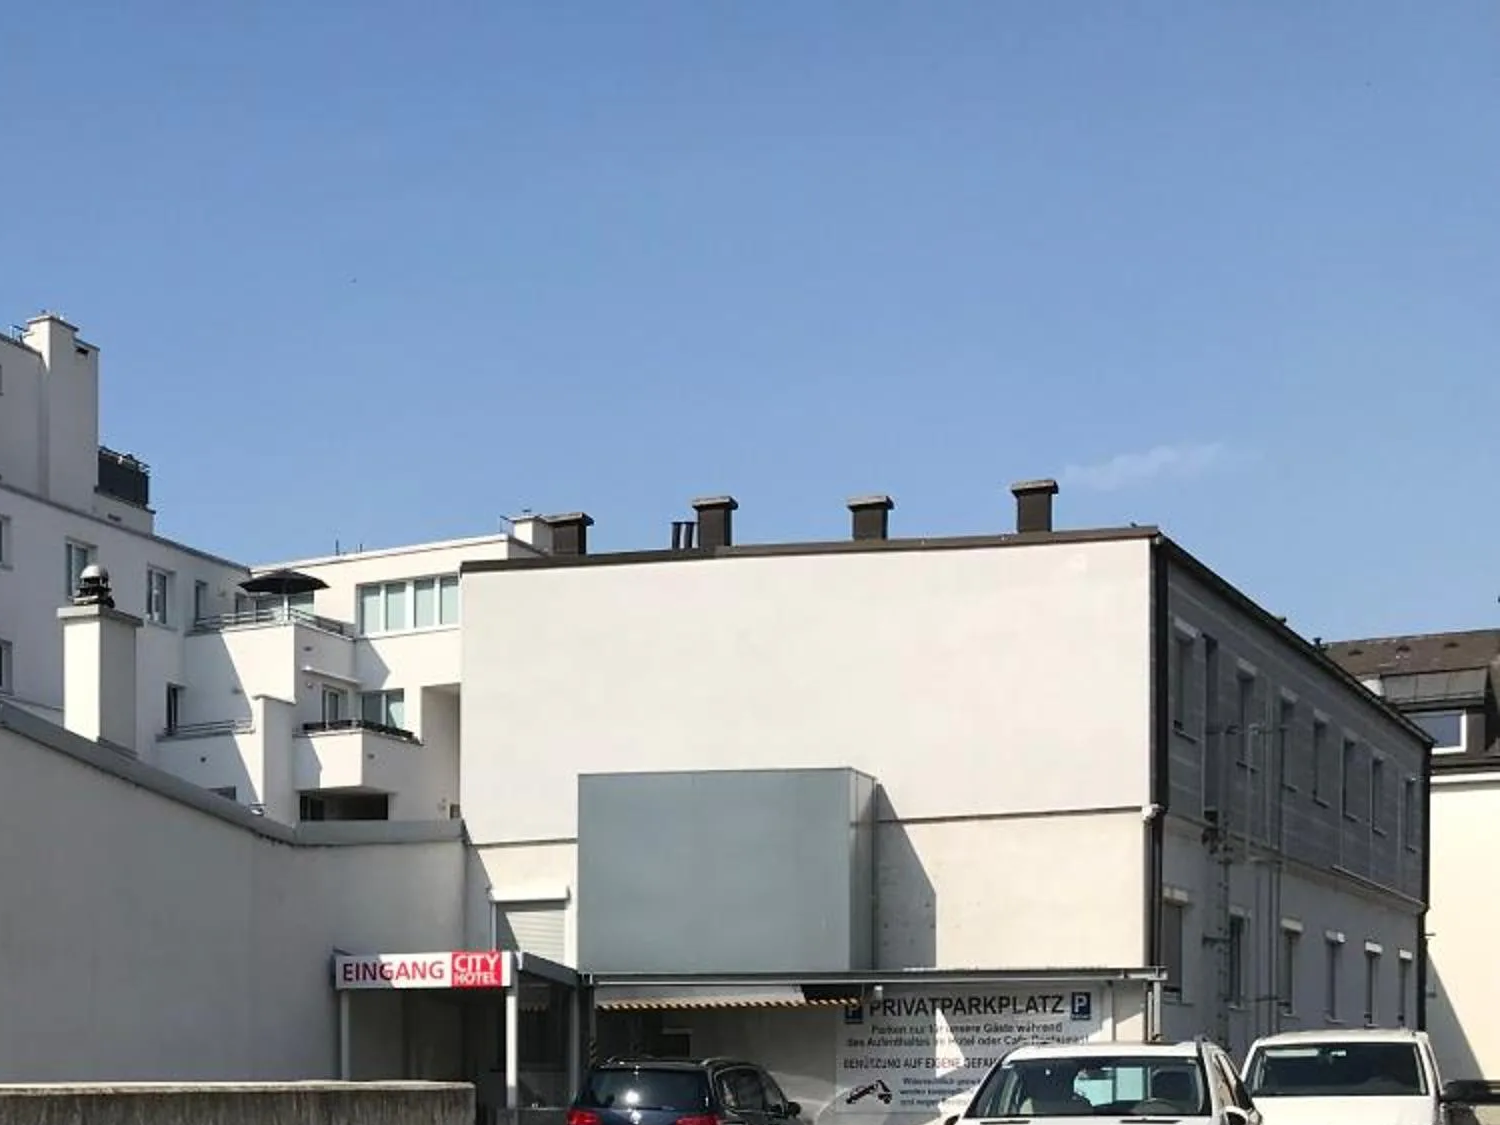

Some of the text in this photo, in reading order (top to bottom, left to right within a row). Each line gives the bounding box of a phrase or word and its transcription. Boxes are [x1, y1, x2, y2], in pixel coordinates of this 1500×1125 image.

[453, 954, 500, 972] CITY
[343, 960, 445, 981] EINGANG
[453, 972, 499, 986] HOTEL
[869, 995, 1065, 1017] PRIVATPARKPLATZ
[983, 1022, 1013, 1033] Gäste
[1016, 1021, 1063, 1033] während
[977, 1035, 1002, 1045] oder
[904, 1057, 924, 1069] AUF
[965, 1056, 998, 1069] GEFAH
